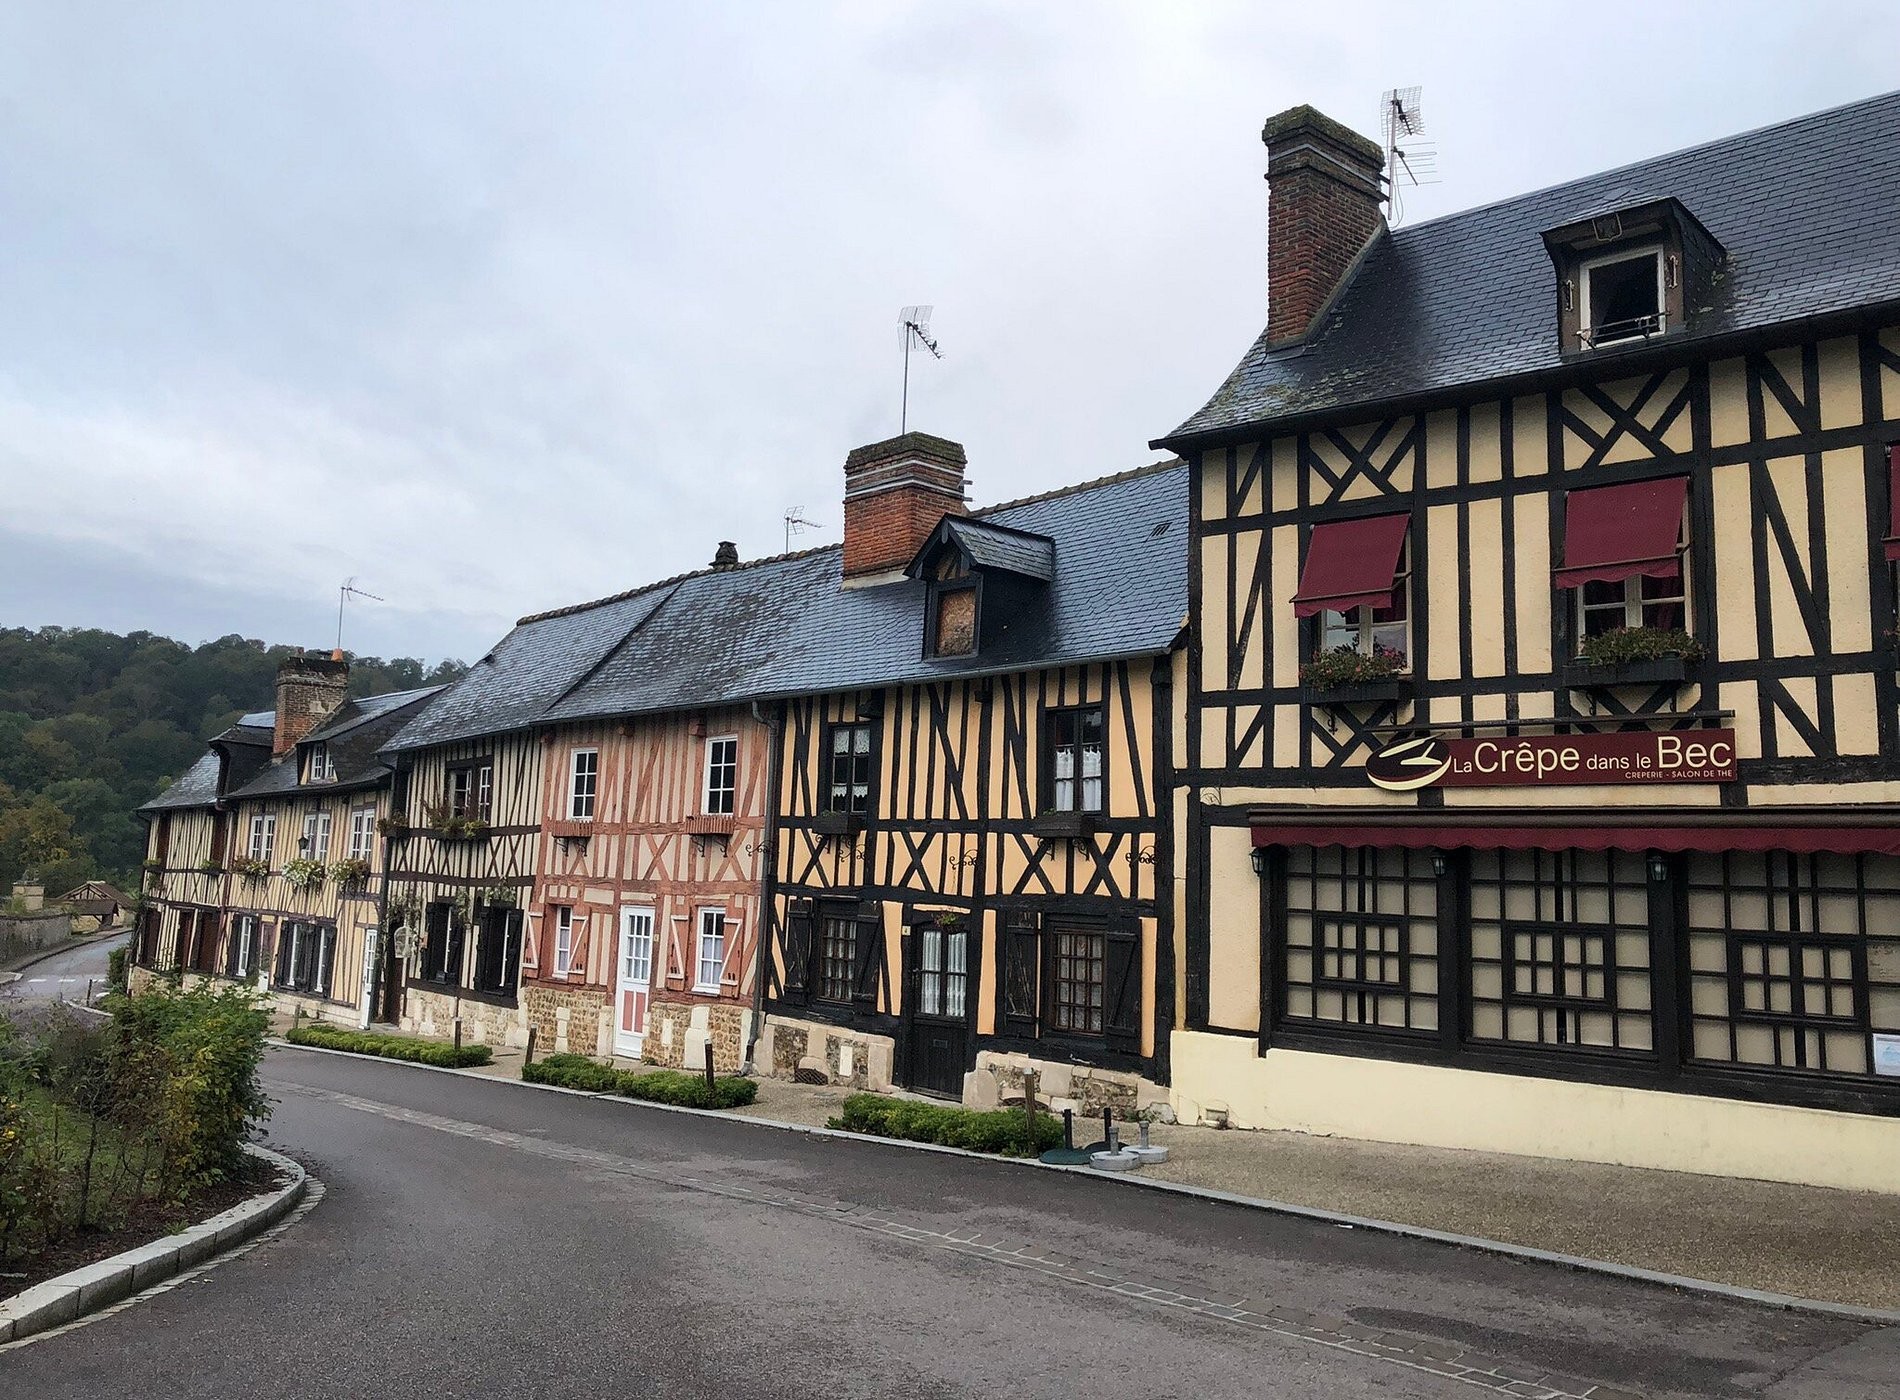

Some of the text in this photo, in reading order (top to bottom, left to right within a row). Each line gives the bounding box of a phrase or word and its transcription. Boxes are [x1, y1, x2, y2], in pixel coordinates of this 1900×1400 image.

[1453, 735, 1732, 779] La Crêpe dans le Bec
[1624, 771, 1663, 779] CREPERIE
[1671, 770, 1701, 778] SALON
[1703, 769, 1715, 777] DE
[1717, 769, 1733, 777] THE
